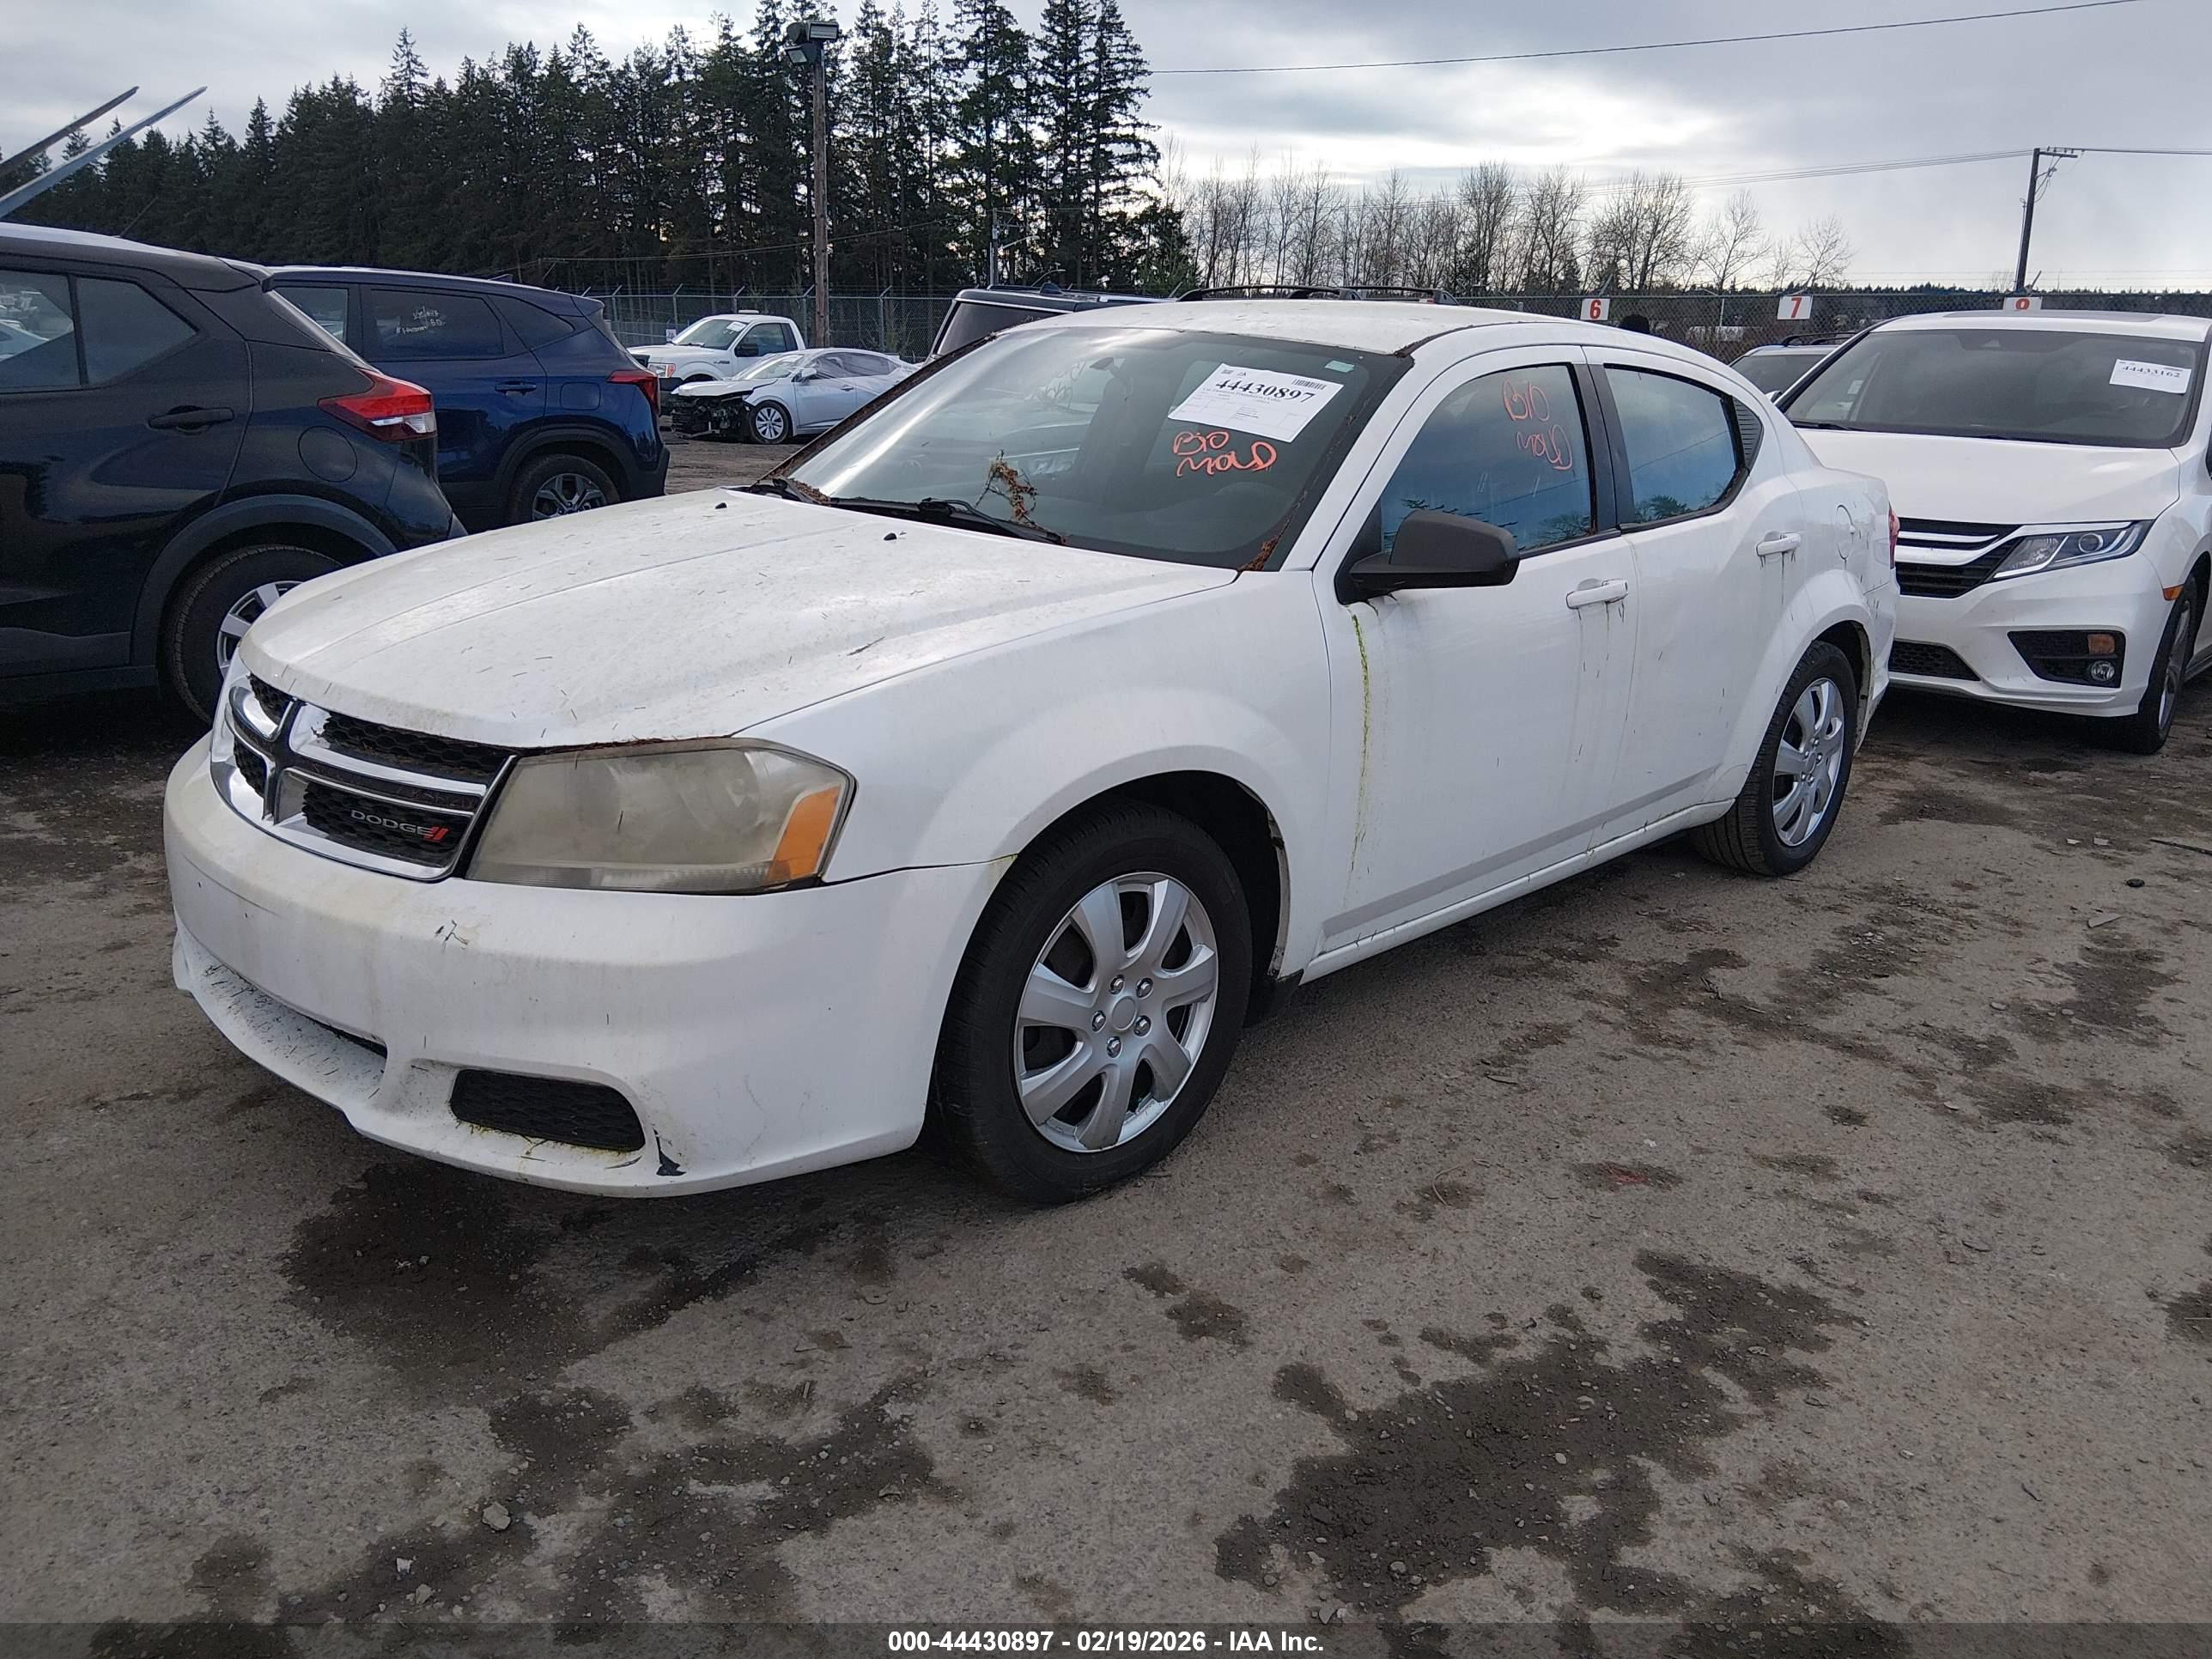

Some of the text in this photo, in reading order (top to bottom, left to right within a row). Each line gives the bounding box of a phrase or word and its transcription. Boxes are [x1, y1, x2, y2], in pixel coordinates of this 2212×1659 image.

[1589, 300, 1601, 319] 6
[1790, 297, 1802, 319] 7
[1215, 379, 1316, 403] 44430897
[350, 810, 434, 837] DODGE
